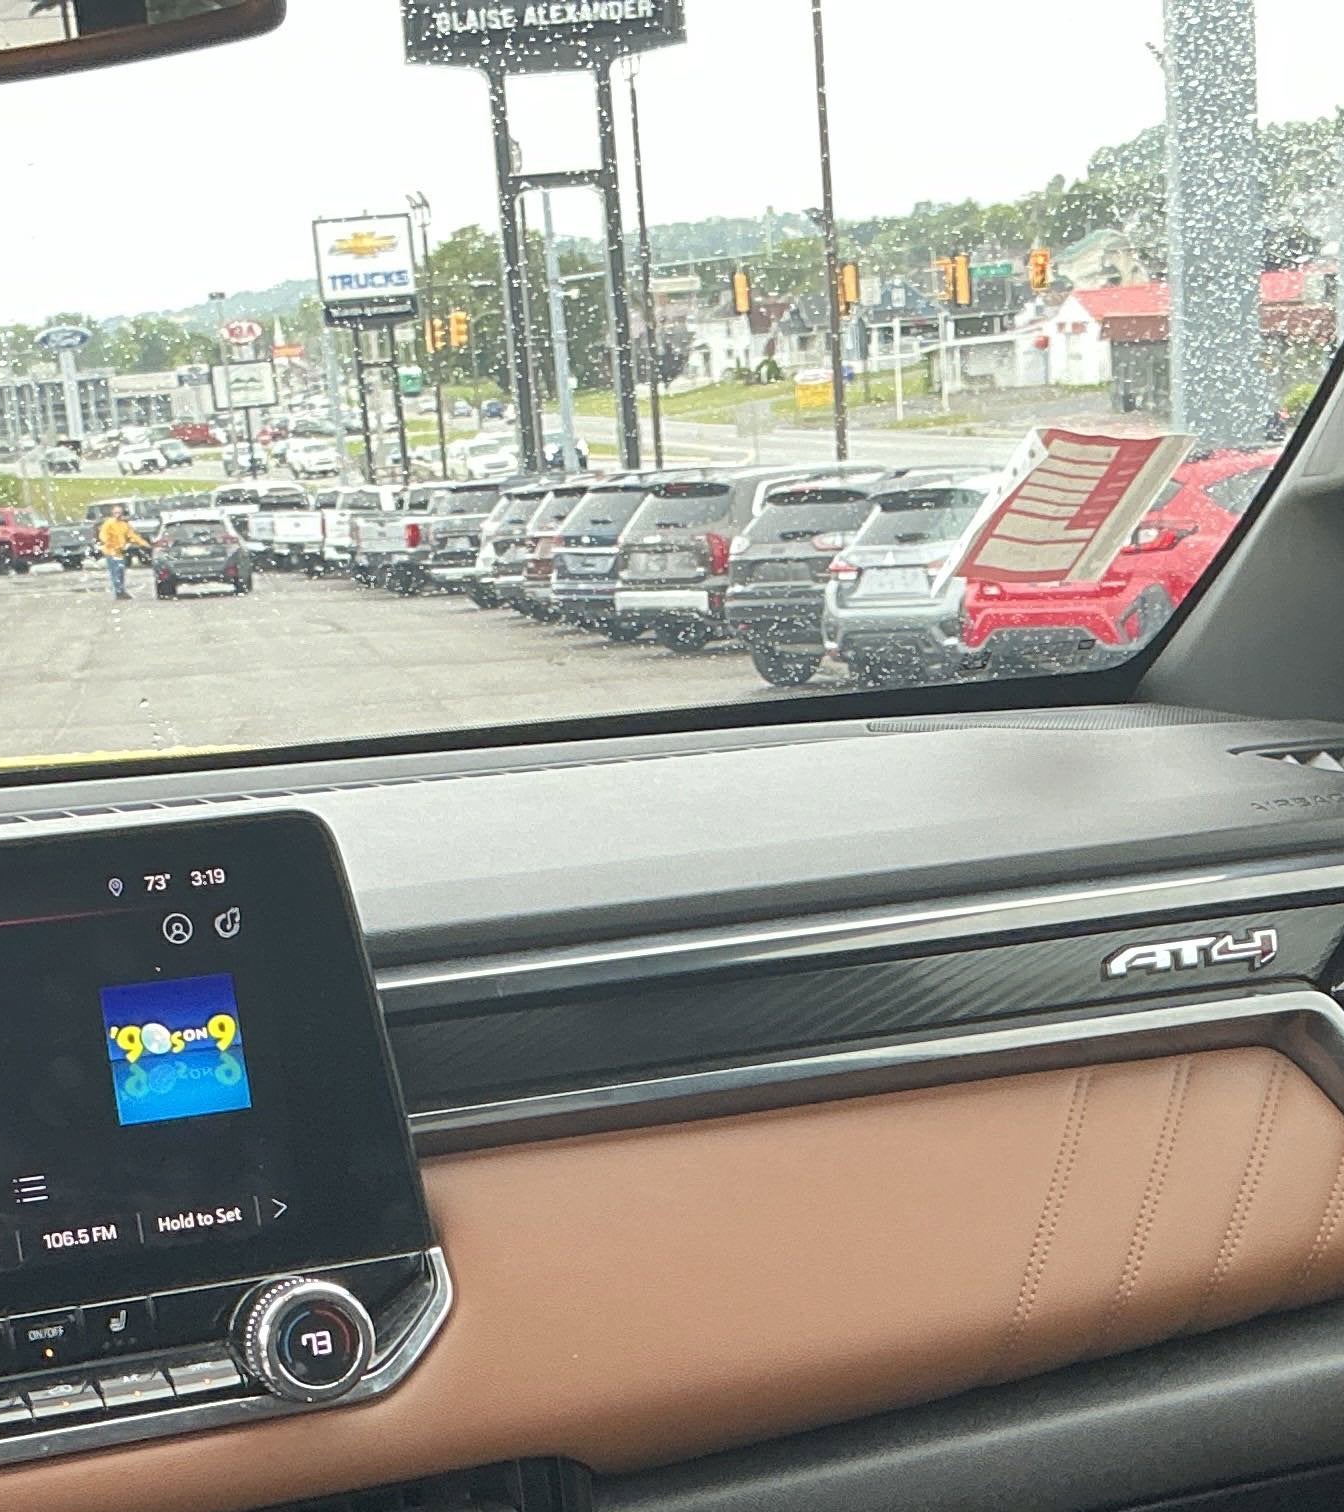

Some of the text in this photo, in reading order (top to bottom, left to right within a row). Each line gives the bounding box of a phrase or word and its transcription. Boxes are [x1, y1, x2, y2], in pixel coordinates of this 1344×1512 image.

[436, 0, 654, 33] BLAISE ALEXANDER
[328, 270, 409, 291] TRUCKS
[190, 868, 226, 887] 3:19
[1103, 926, 1278, 980] AT4
[158, 1207, 243, 1232] Hold to Set
[42, 1224, 118, 1249] 106.5 FM
[300, 1330, 333, 1357] 73
